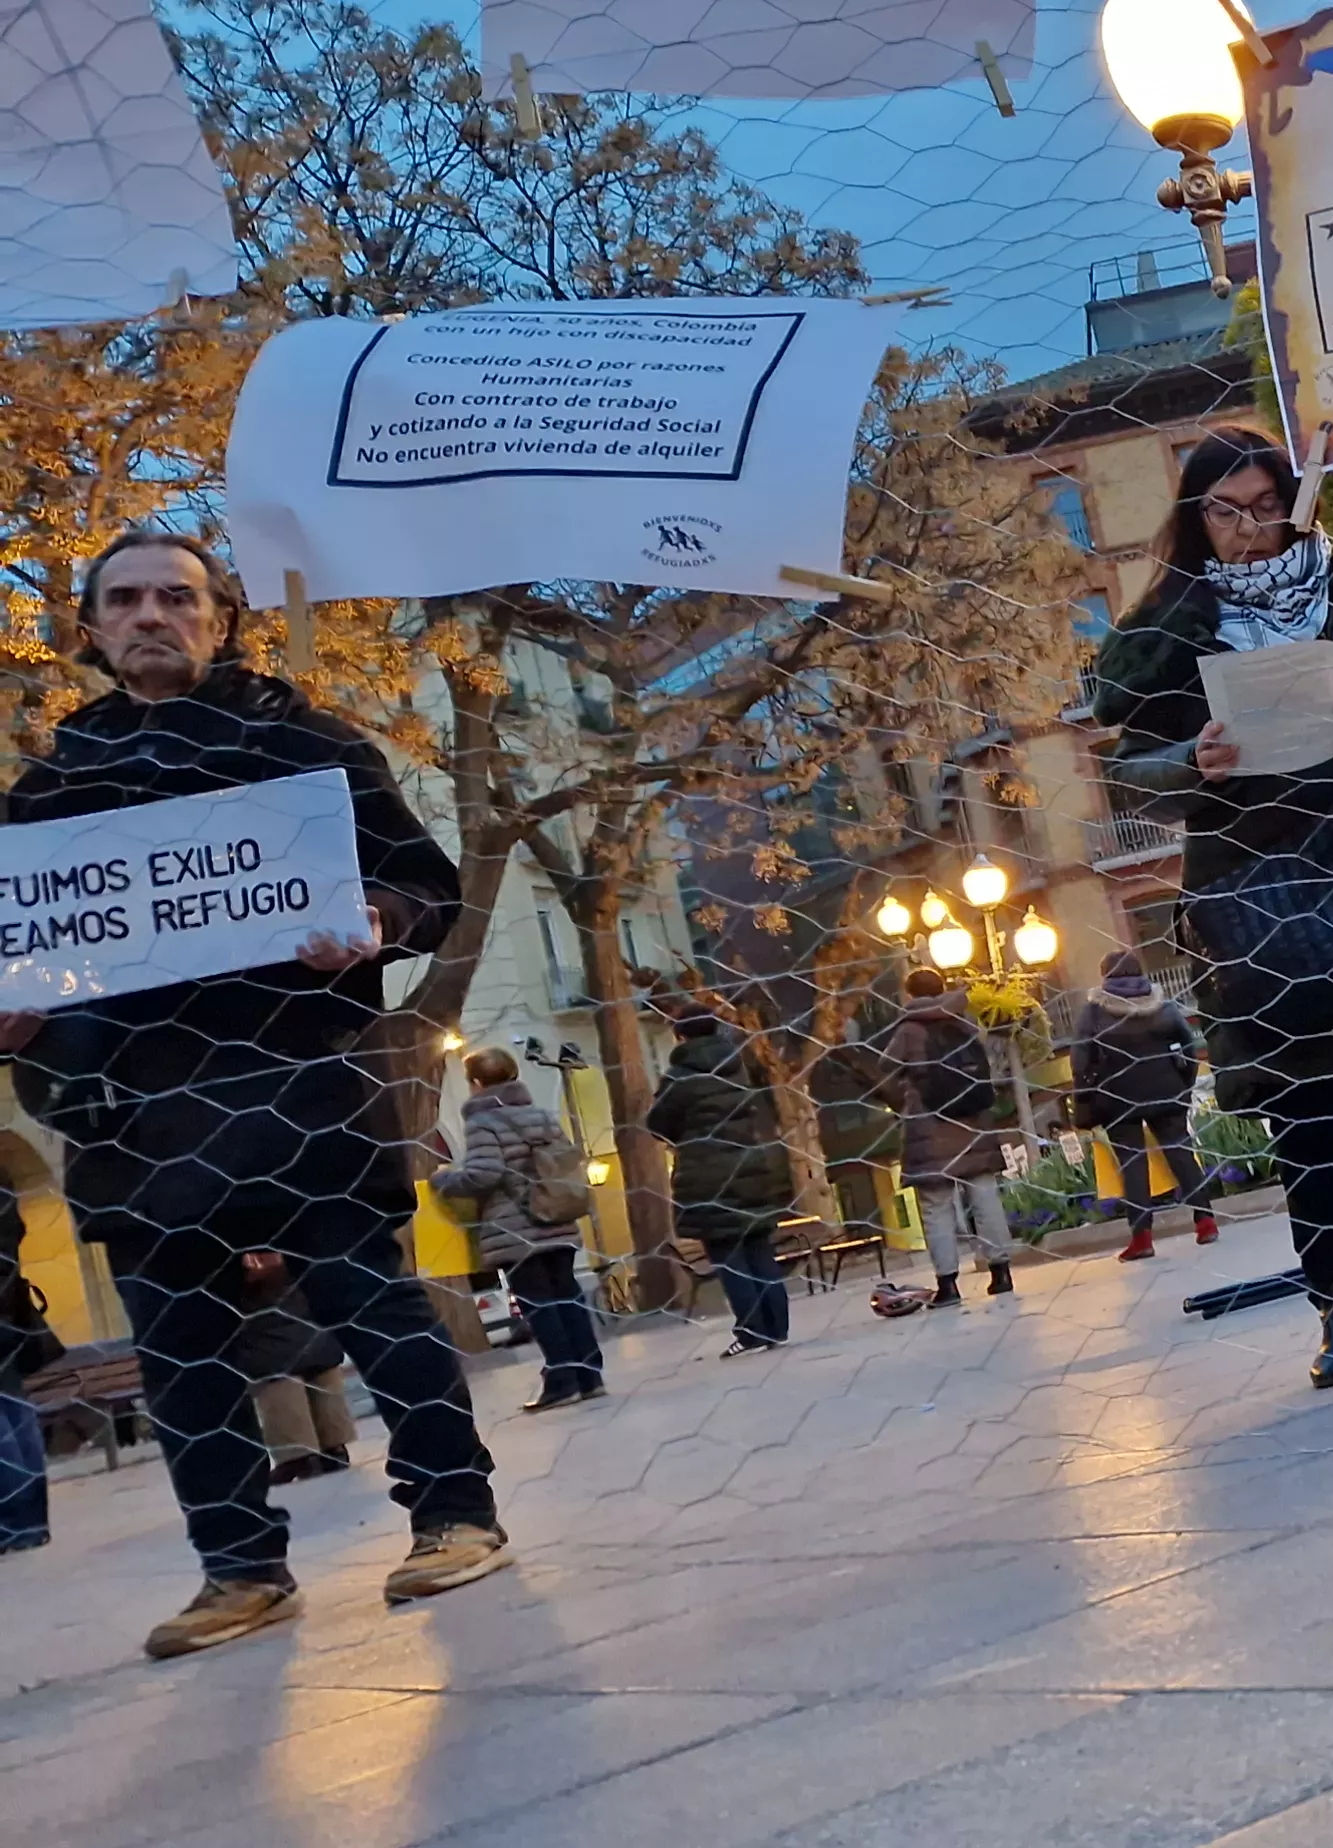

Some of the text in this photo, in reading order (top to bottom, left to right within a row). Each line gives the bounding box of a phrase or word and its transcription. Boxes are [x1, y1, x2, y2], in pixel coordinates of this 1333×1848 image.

[424, 324, 754, 347] con un hijo con discapacidad
[653, 318, 758, 332] Colombia
[407, 353, 726, 374] Concedido ASILO por razones
[481, 372, 634, 389] Humanitarias
[414, 391, 678, 413] Con contrato de trabajo
[368, 413, 722, 441] y cotizando a la Seguridad Social
[356, 437, 725, 464] No encuentra vivienda de alquiler
[642, 514, 723, 533] BIENVENIDXS
[147, 837, 262, 888] EXILIO
[152, 877, 310, 935] REFUGIO
